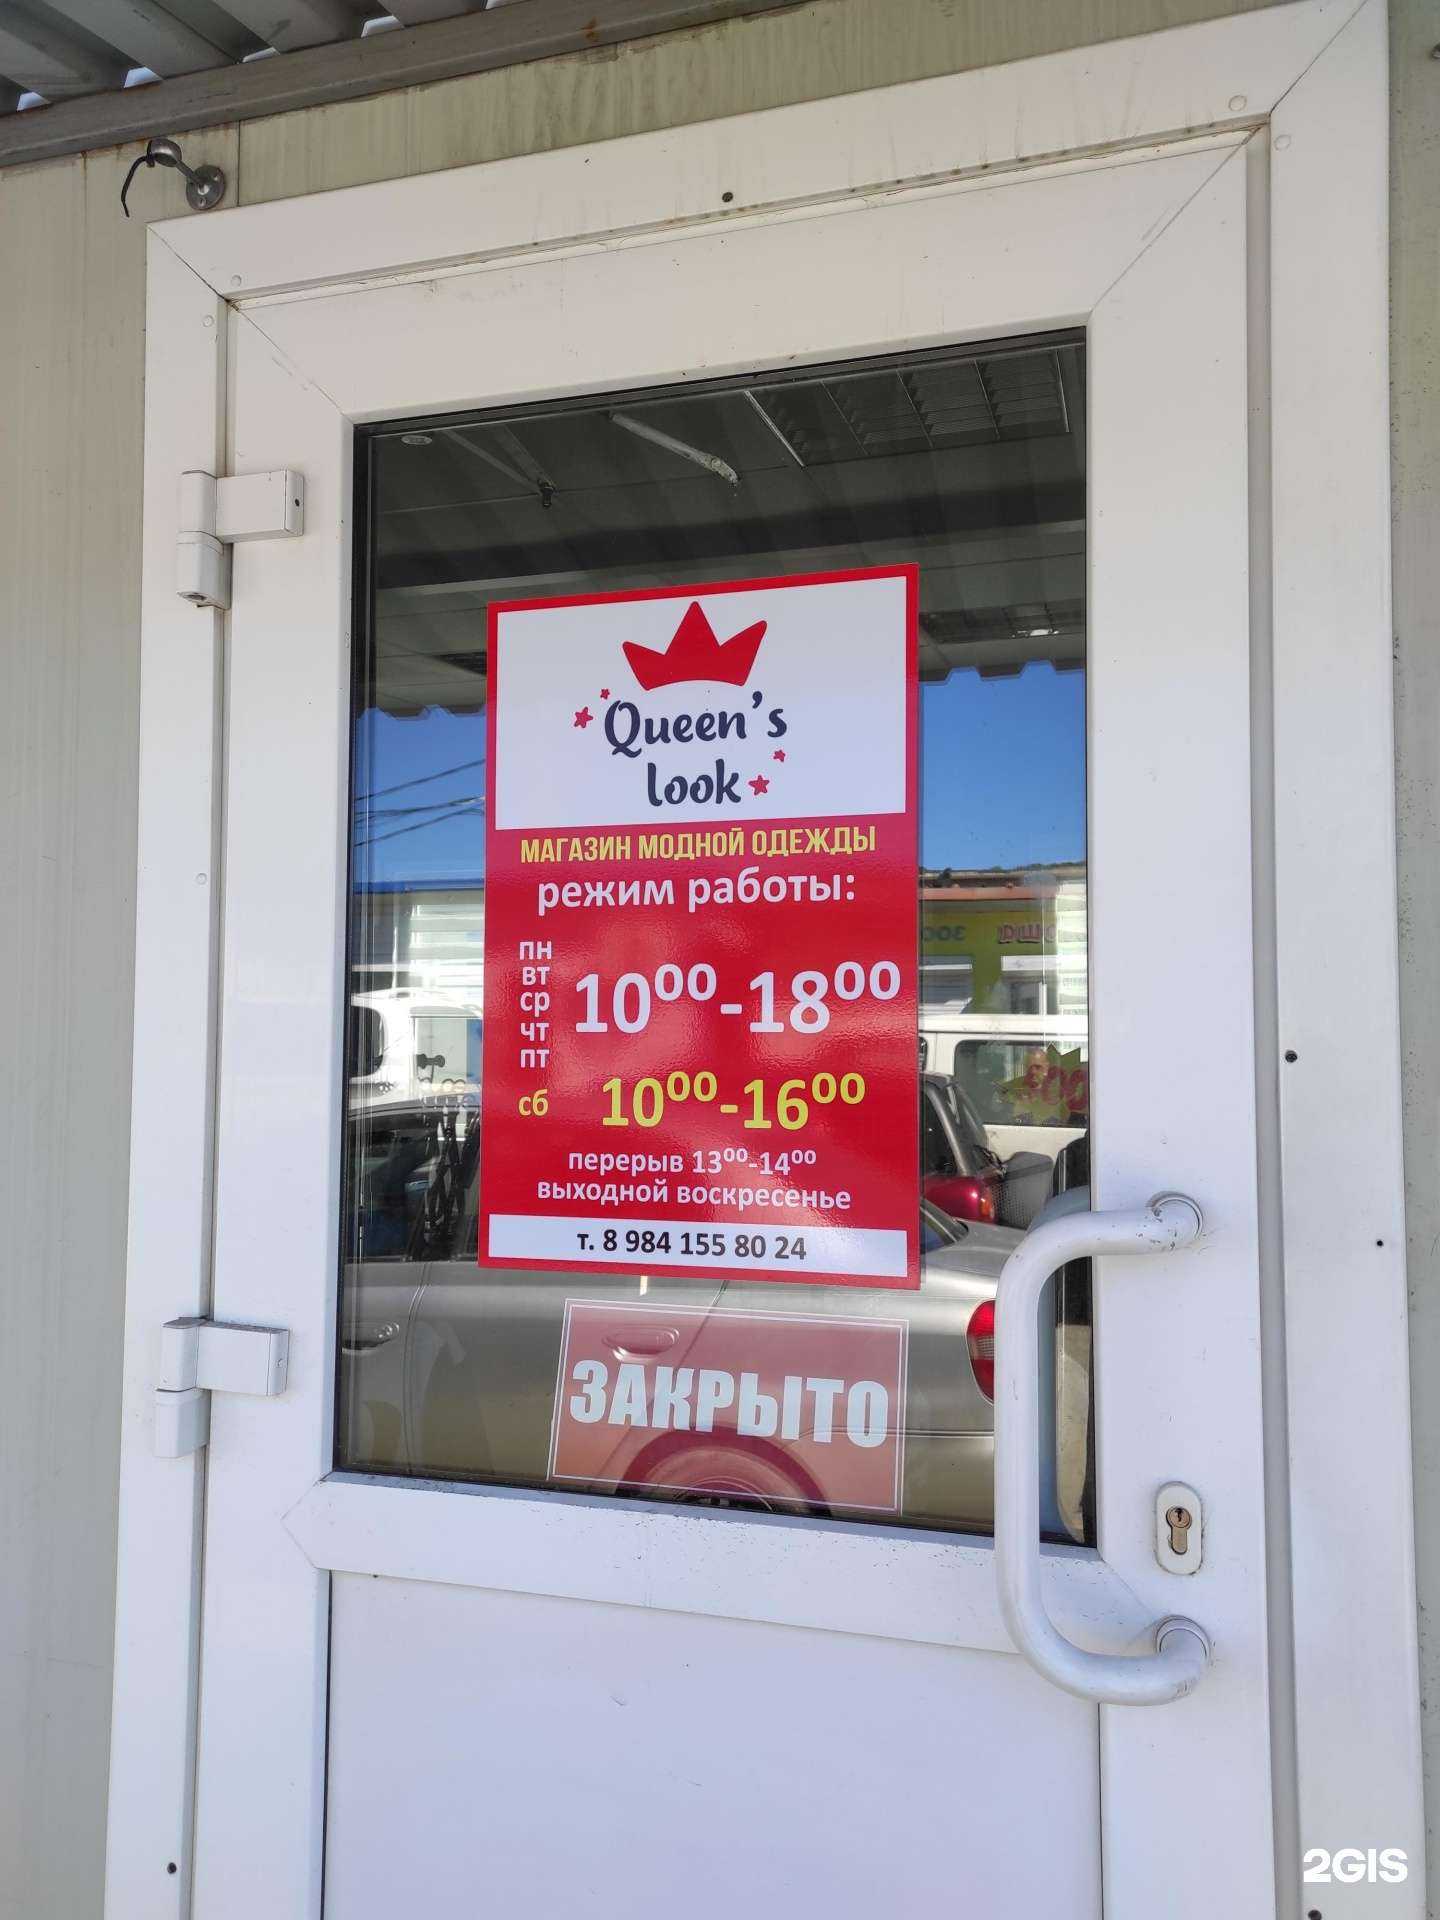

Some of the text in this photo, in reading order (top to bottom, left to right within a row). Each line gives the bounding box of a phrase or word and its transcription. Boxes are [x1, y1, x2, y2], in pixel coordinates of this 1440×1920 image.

[604, 690, 788, 758] Queen's
[647, 758, 742, 807] look
[520, 825, 876, 863] МАГАЗИН МОДНОЙ ОДЕЖДЫ
[537, 866, 855, 916] режим работы:
[519, 941, 553, 960] пн
[522, 966, 549, 986] вт
[520, 991, 550, 1016] ср
[520, 1021, 550, 1042] чт
[520, 1048, 550, 1068] пт
[518, 1089, 549, 1117] сб
[568, 1152, 683, 1177] перерыв
[537, 1179, 851, 1210] выходной воскресенье
[577, 1230, 807, 1260] т. 8 984 155 80 24
[569, 1359, 888, 1448] ЗАКРЫТО
